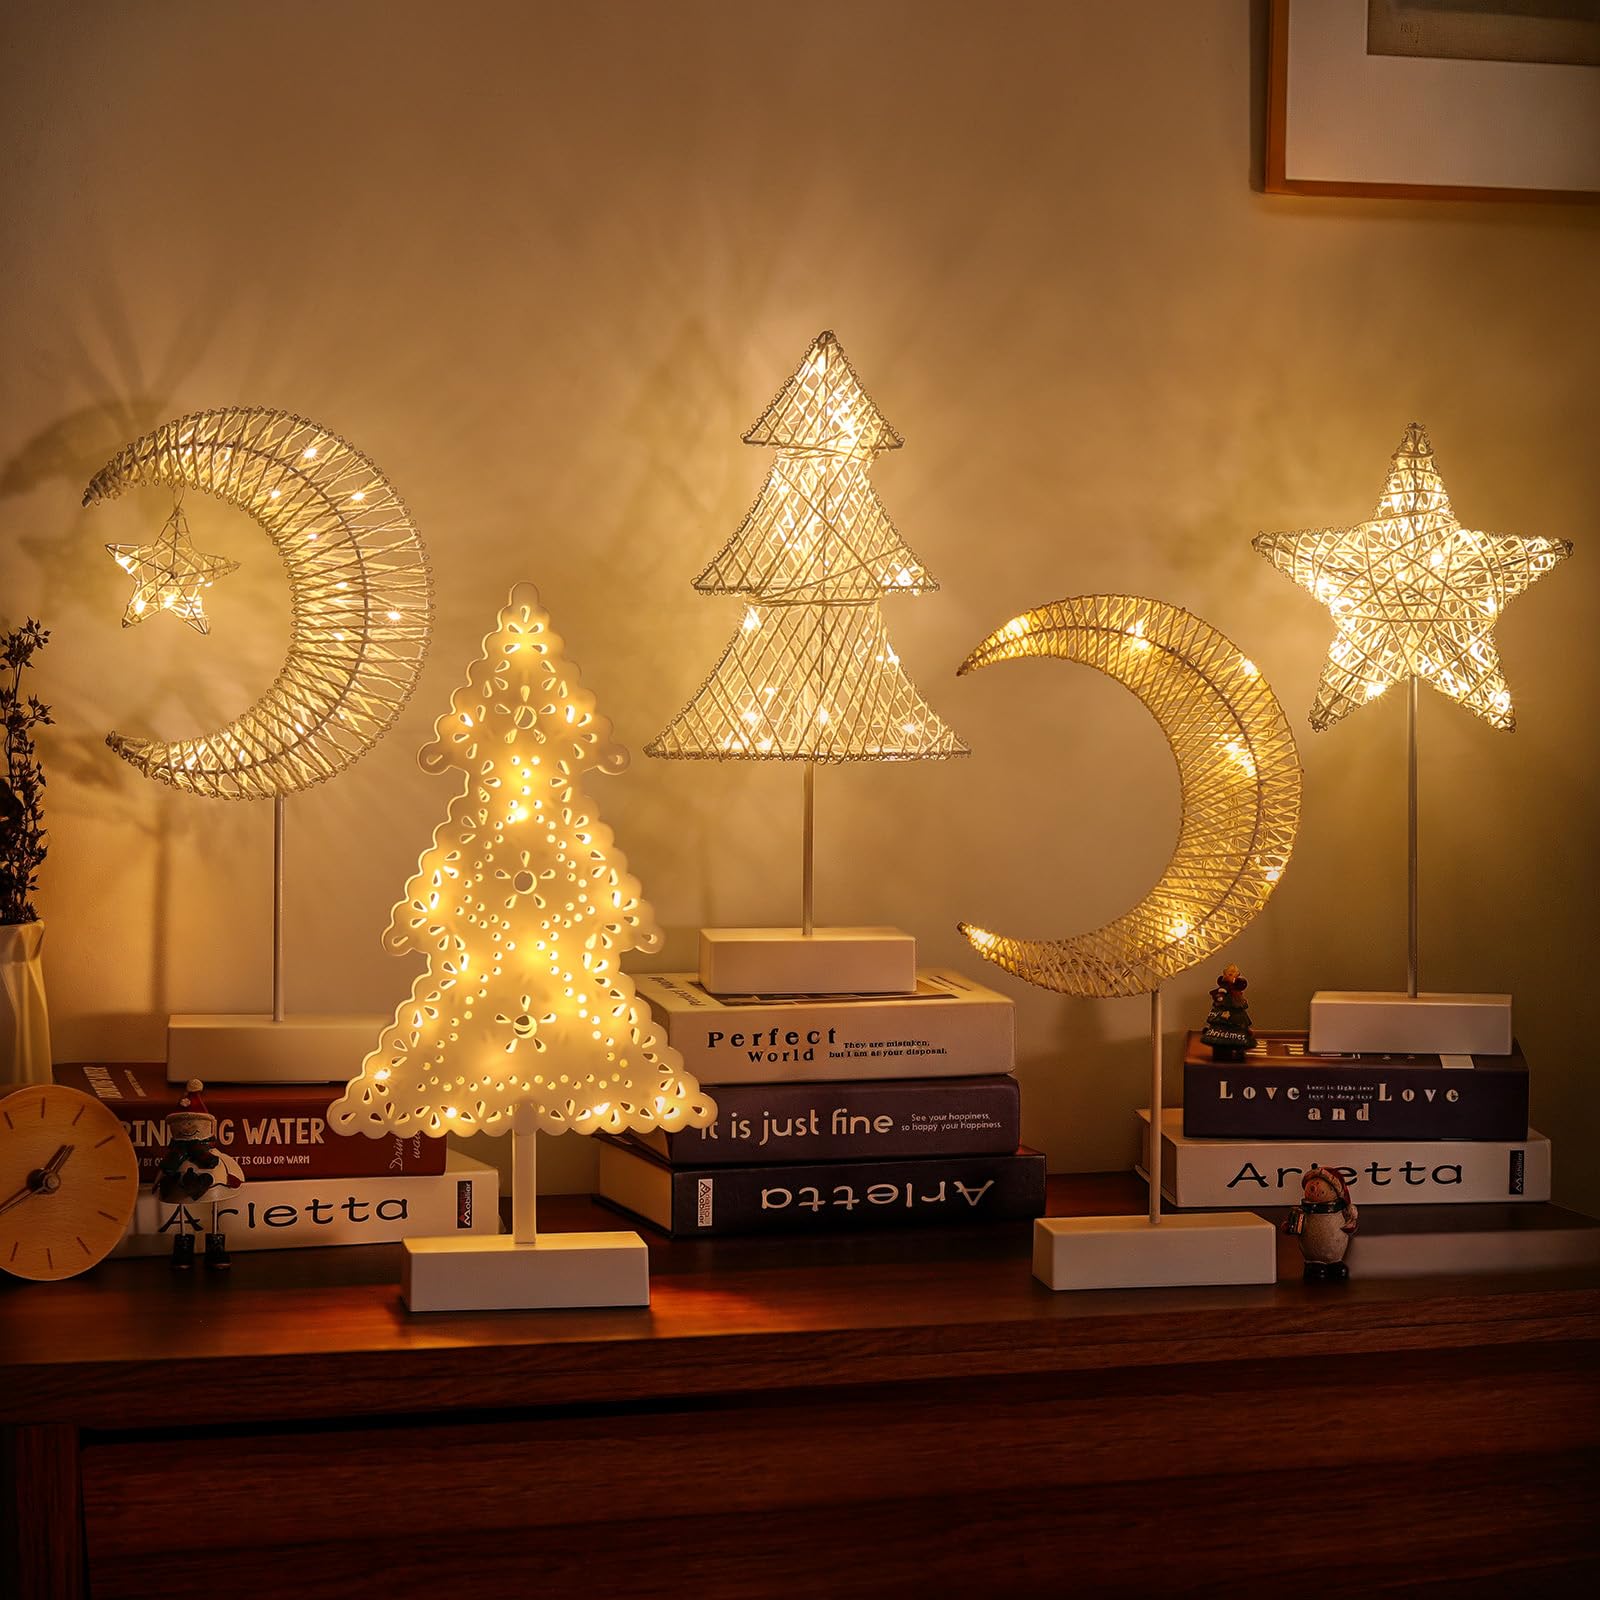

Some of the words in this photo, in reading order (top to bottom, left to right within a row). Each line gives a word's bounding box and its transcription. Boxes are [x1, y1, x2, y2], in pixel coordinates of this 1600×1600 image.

[707, 1027, 836, 1048] Perfect
[843, 1042, 866, 1050] They
[882, 1049, 903, 1058] your
[1218, 1080, 1300, 1101] Love
[1378, 1082, 1460, 1102] Love
[911, 1113, 927, 1122] See
[928, 1114, 947, 1123] your
[1307, 1103, 1370, 1122] and
[241, 1117, 325, 1146] WATER
[731, 1111, 751, 1140] is
[759, 1109, 820, 1146] just
[831, 1107, 894, 1136] fine
[911, 1122, 938, 1132] happy
[940, 1122, 959, 1132] your
[252, 1155, 272, 1166] COLD
[273, 1155, 285, 1165] OR
[286, 1154, 310, 1165] WARM
[1226, 1161, 1463, 1188] Aretta
[760, 1179, 996, 1212] Arletta
